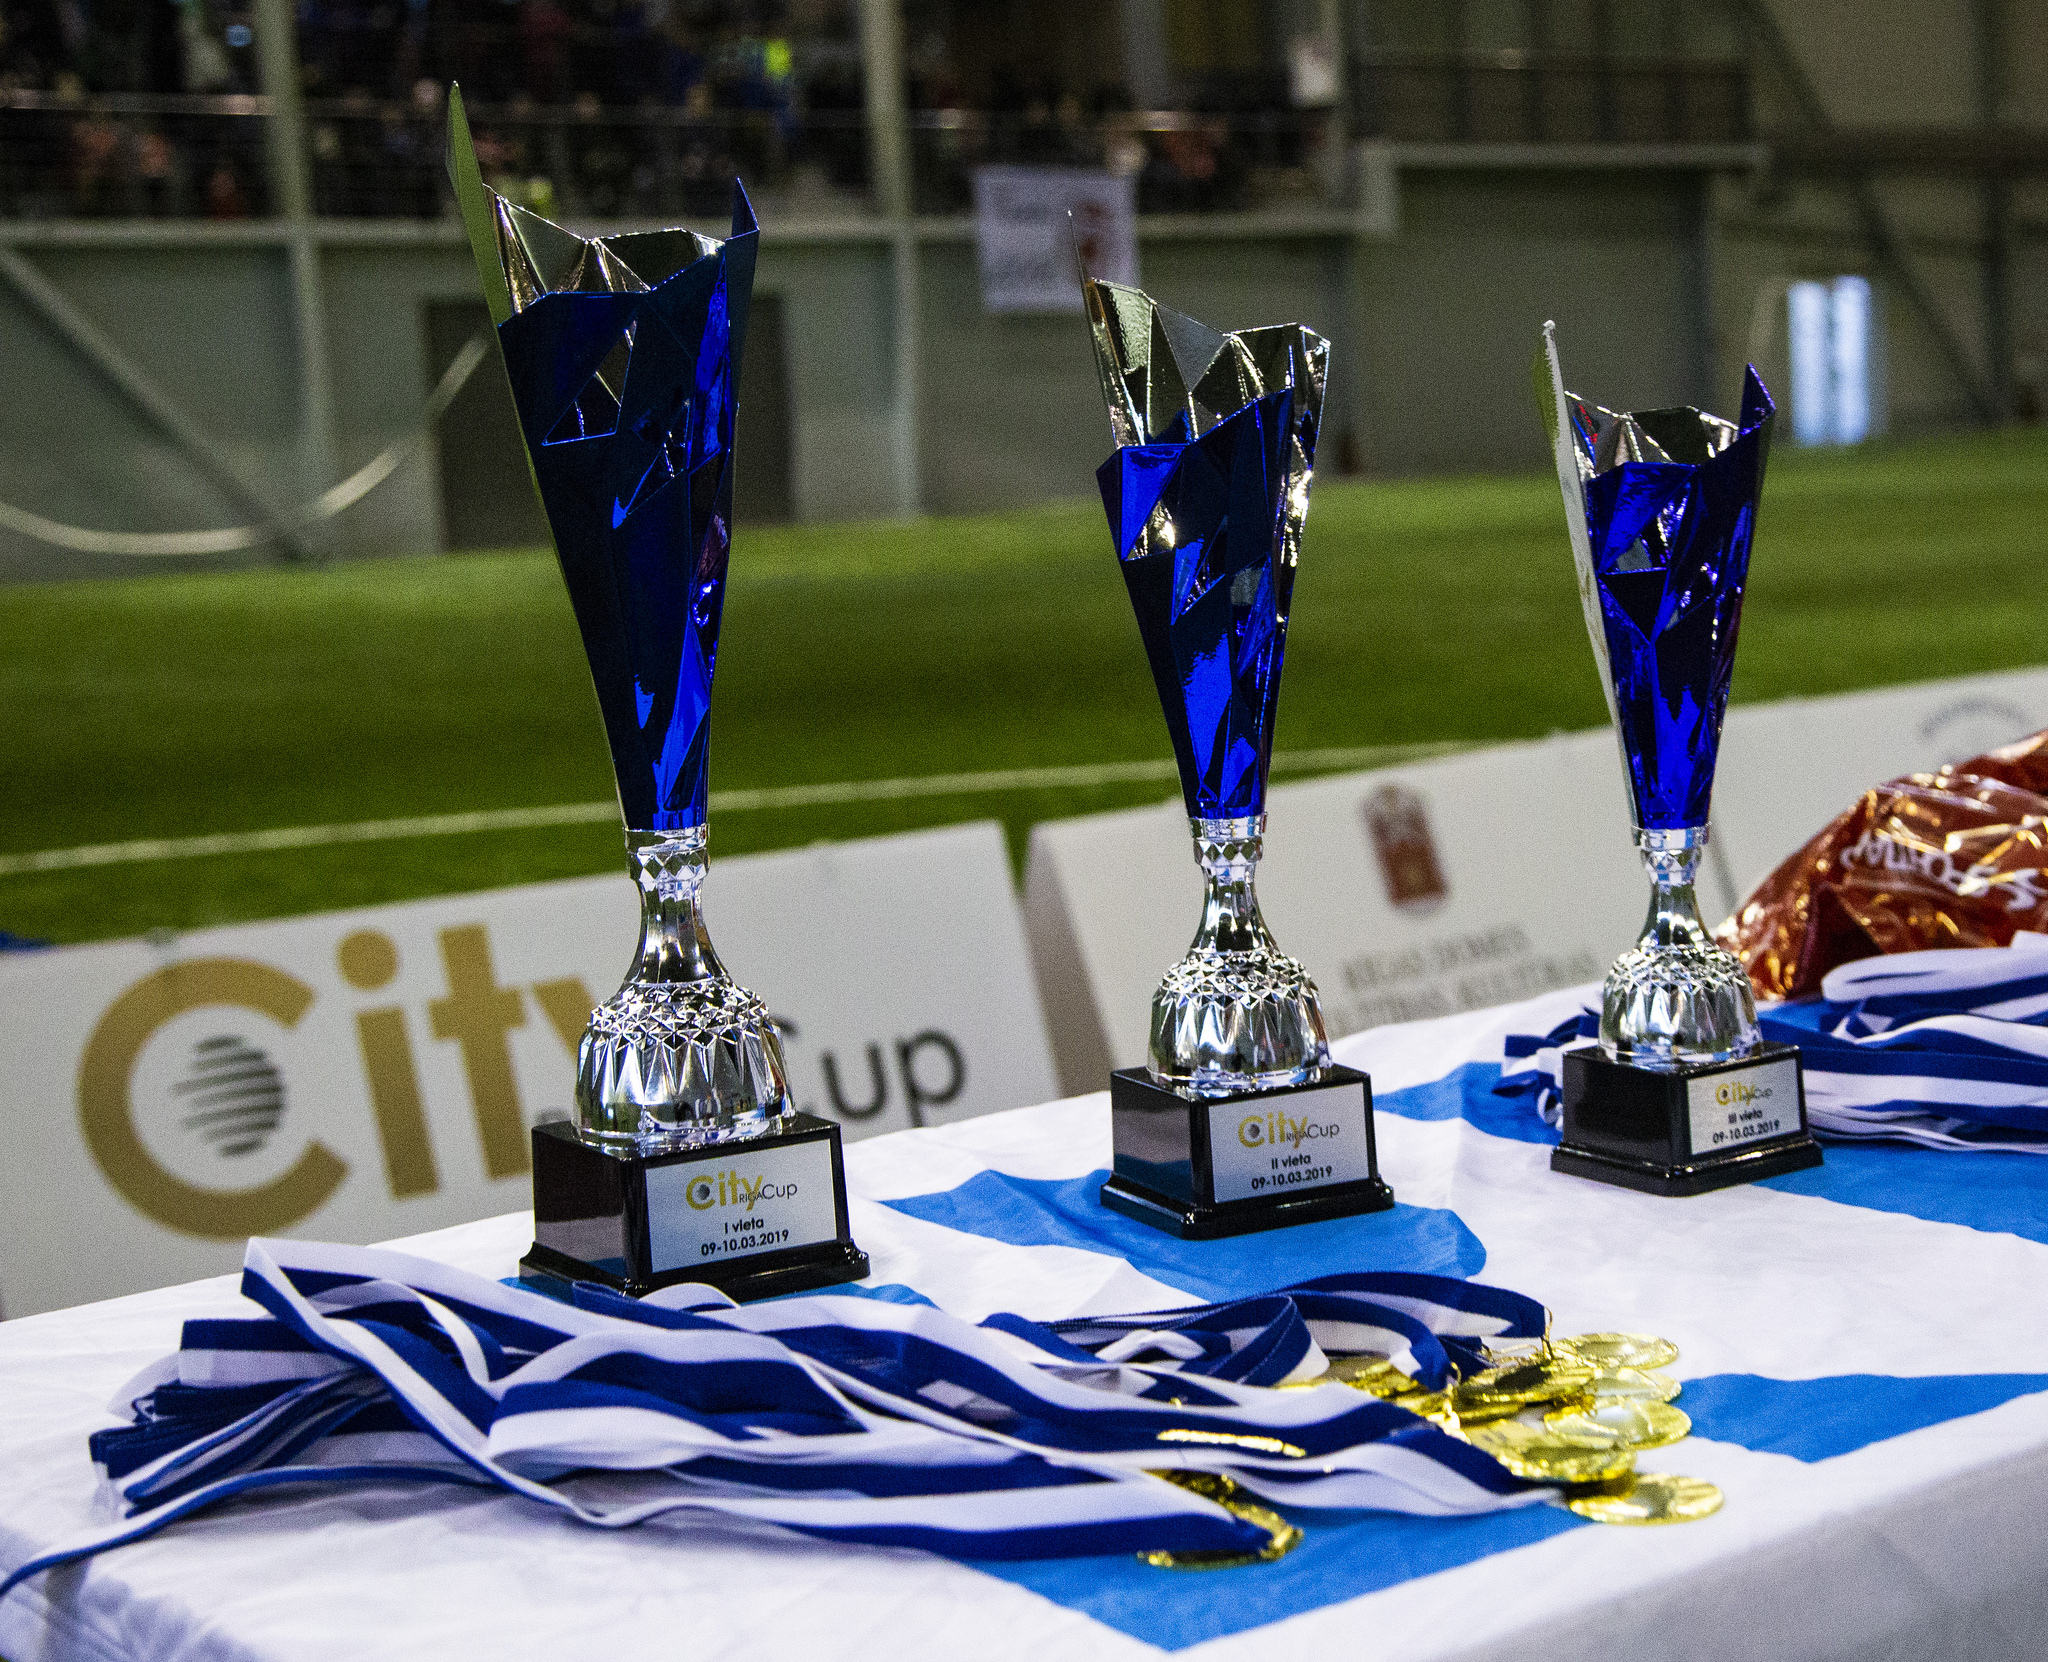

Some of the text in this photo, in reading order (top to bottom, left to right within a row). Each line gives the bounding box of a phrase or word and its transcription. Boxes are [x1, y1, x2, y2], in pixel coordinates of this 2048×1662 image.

[772, 1014, 967, 1127] up
[1715, 1082, 1755, 1106] City
[1238, 1111, 1308, 1149] City
[1307, 1123, 1340, 1139] Cup
[1712, 1119, 1780, 1144] 09-10.03.2019
[1271, 1153, 1311, 1170] II vieta
[1251, 1165, 1333, 1189] 09-10.03.2019
[685, 1171, 763, 1211] City
[762, 1183, 798, 1201] Cup
[724, 1217, 764, 1234] I vieta
[701, 1229, 789, 1256] 09-10.03.2019
